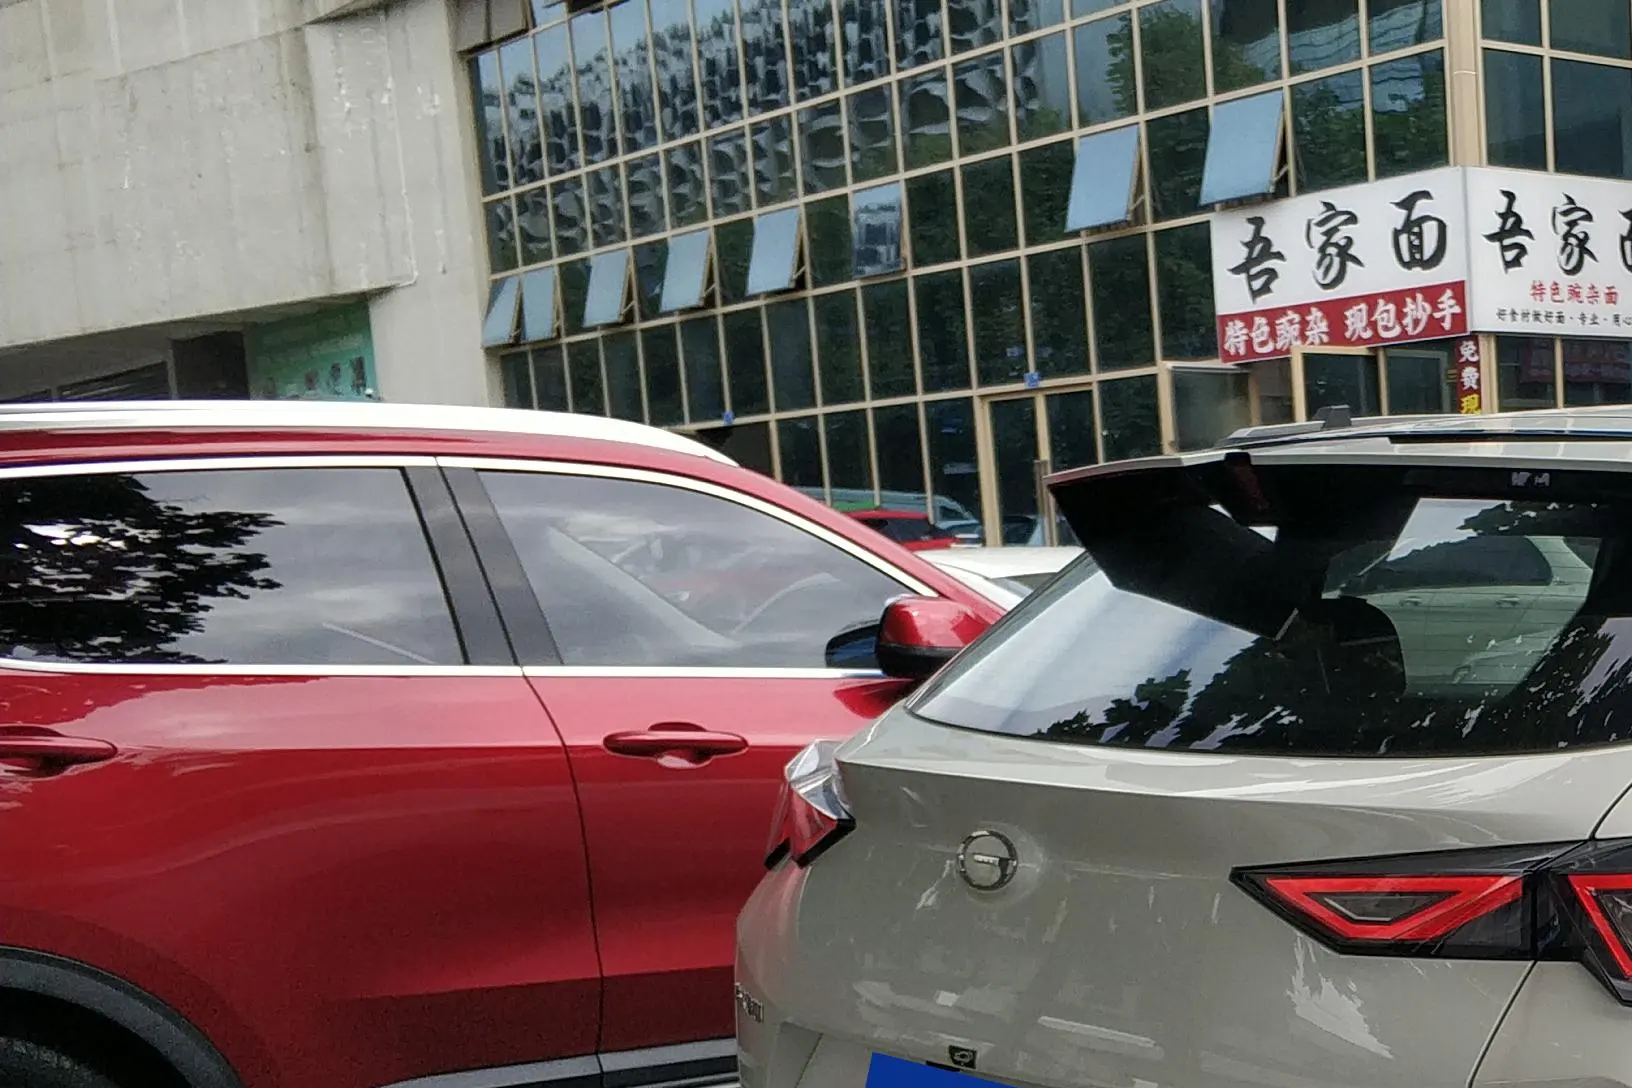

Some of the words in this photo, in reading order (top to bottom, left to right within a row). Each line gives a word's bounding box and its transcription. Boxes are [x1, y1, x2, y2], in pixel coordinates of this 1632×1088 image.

[1228, 190, 1447, 304] 吾家面
[1224, 308, 1330, 356] 特色豌杂
[1344, 288, 1462, 341] 现包抄手
